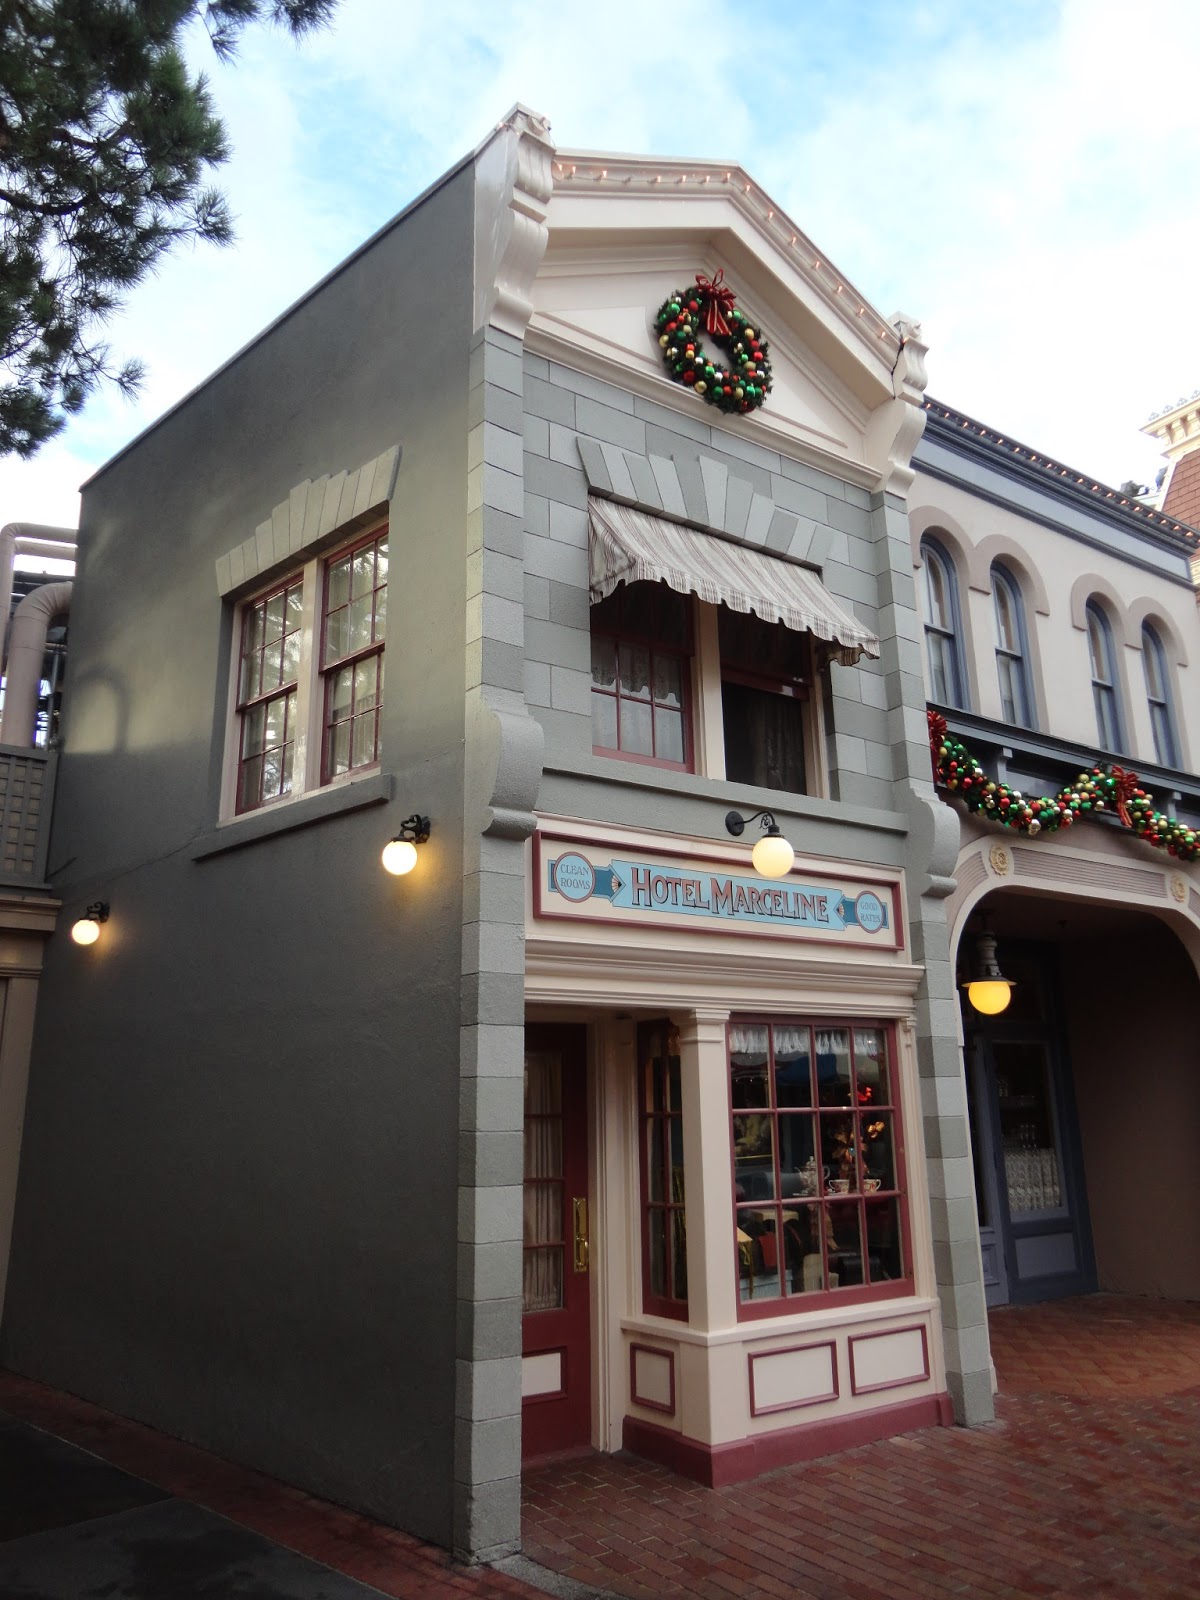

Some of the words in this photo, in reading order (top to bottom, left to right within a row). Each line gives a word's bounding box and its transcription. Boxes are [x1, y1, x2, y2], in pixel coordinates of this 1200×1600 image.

[560, 863, 589, 876] CLEAN
[560, 877, 591, 890] ROOMS
[631, 867, 711, 909] HOTEL
[711, 878, 829, 922] MARCELINE
[860, 901, 878, 911] GOOD
[860, 912, 881, 923] RATES
